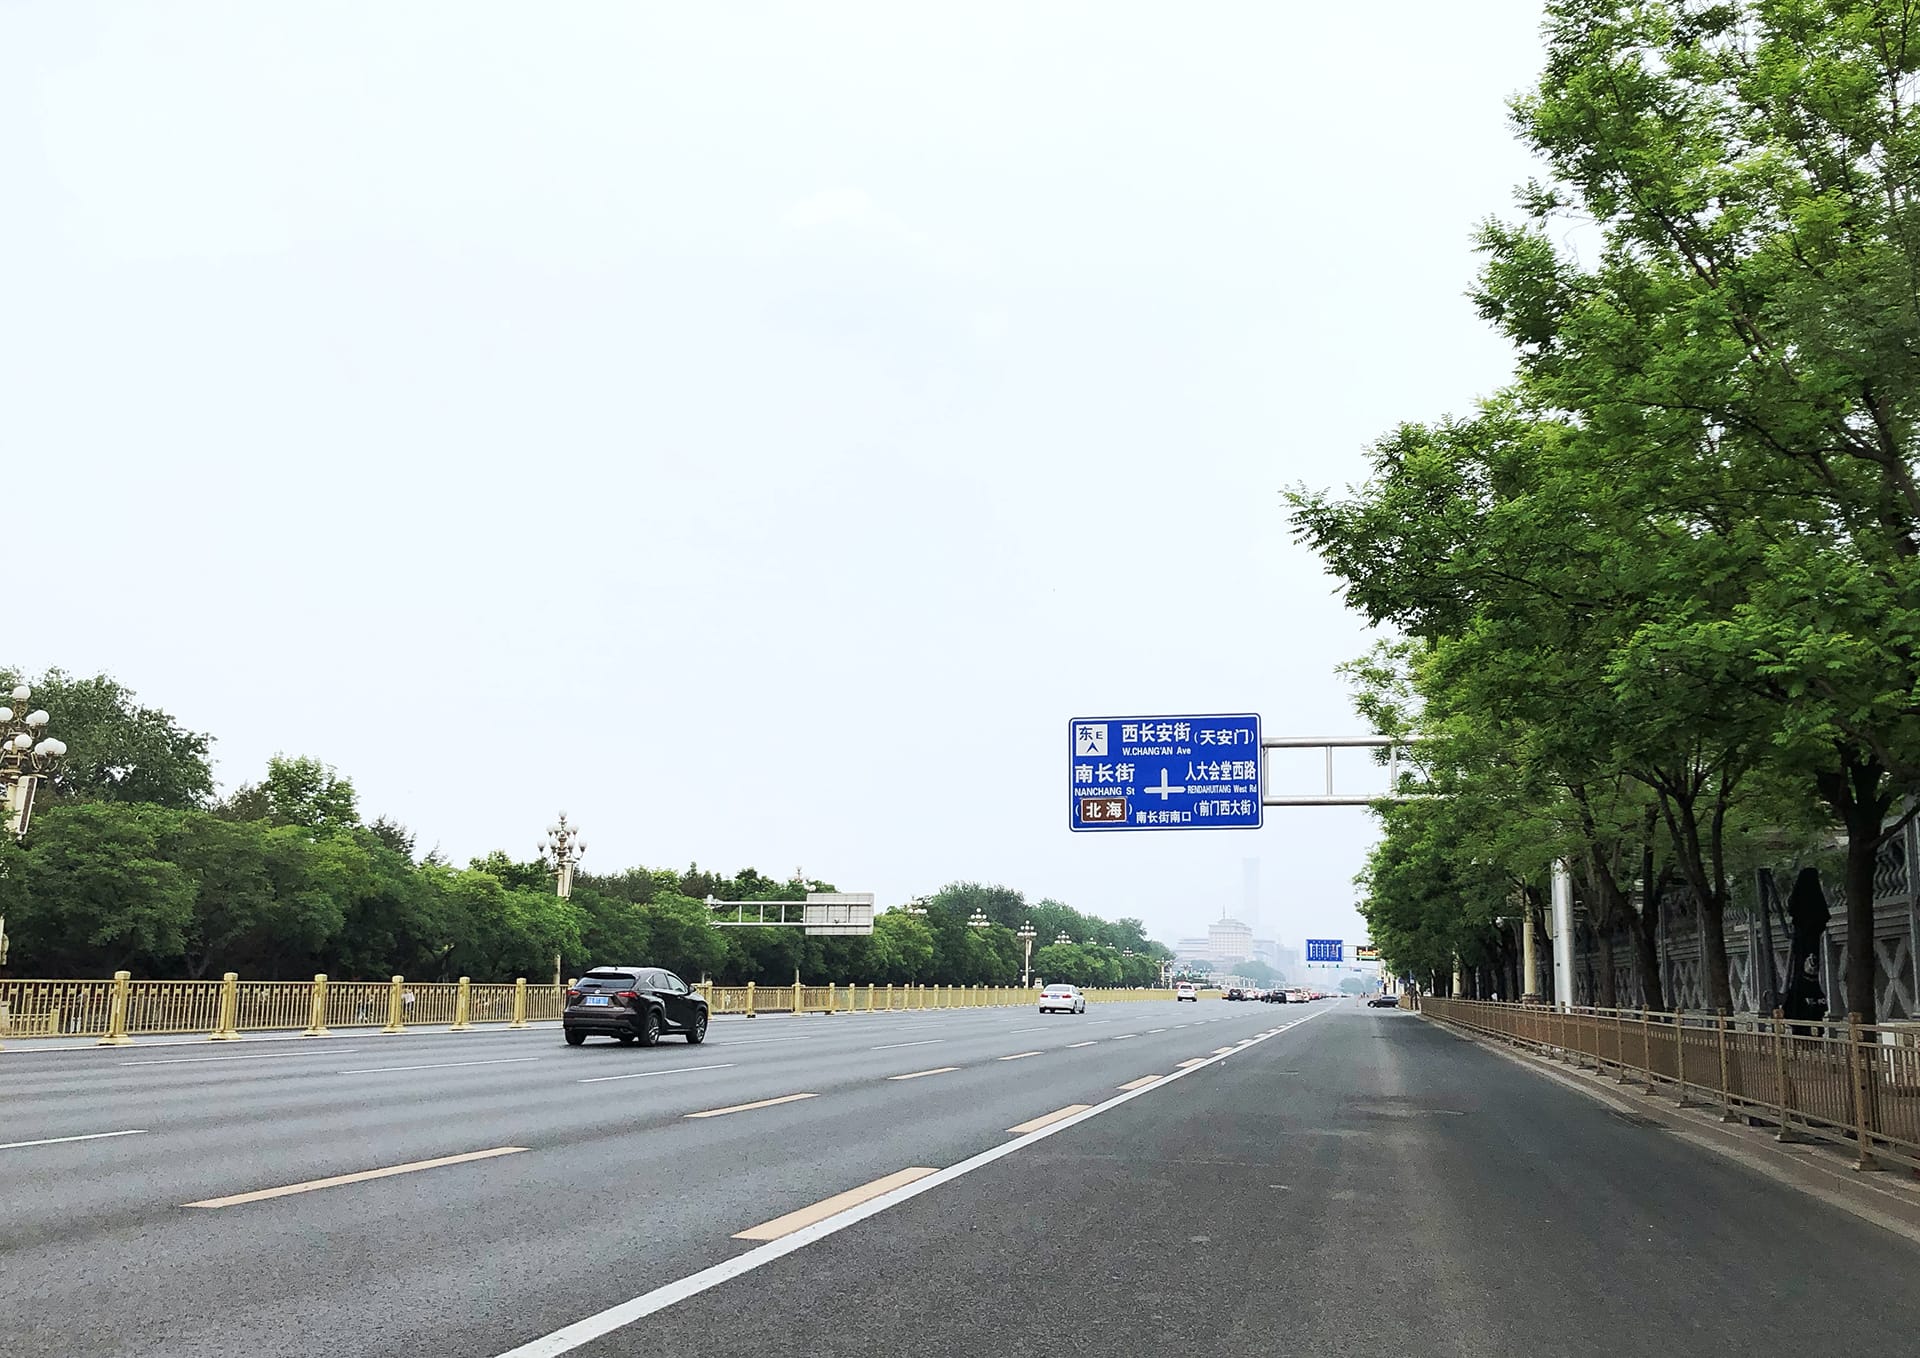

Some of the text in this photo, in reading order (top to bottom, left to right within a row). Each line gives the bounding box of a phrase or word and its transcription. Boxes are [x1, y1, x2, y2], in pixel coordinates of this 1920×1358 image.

[1121, 722, 1191, 743] 西长安街
[1176, 746, 1191, 755] Ave
[1074, 762, 1136, 784] 南长街
[1185, 760, 1257, 781] 人大会堂西路
[1074, 786, 1135, 797] NANCHANG St
[1187, 783, 1257, 794] RENDAHUITANG West Rd
[1136, 810, 1191, 824] 南长街南口
